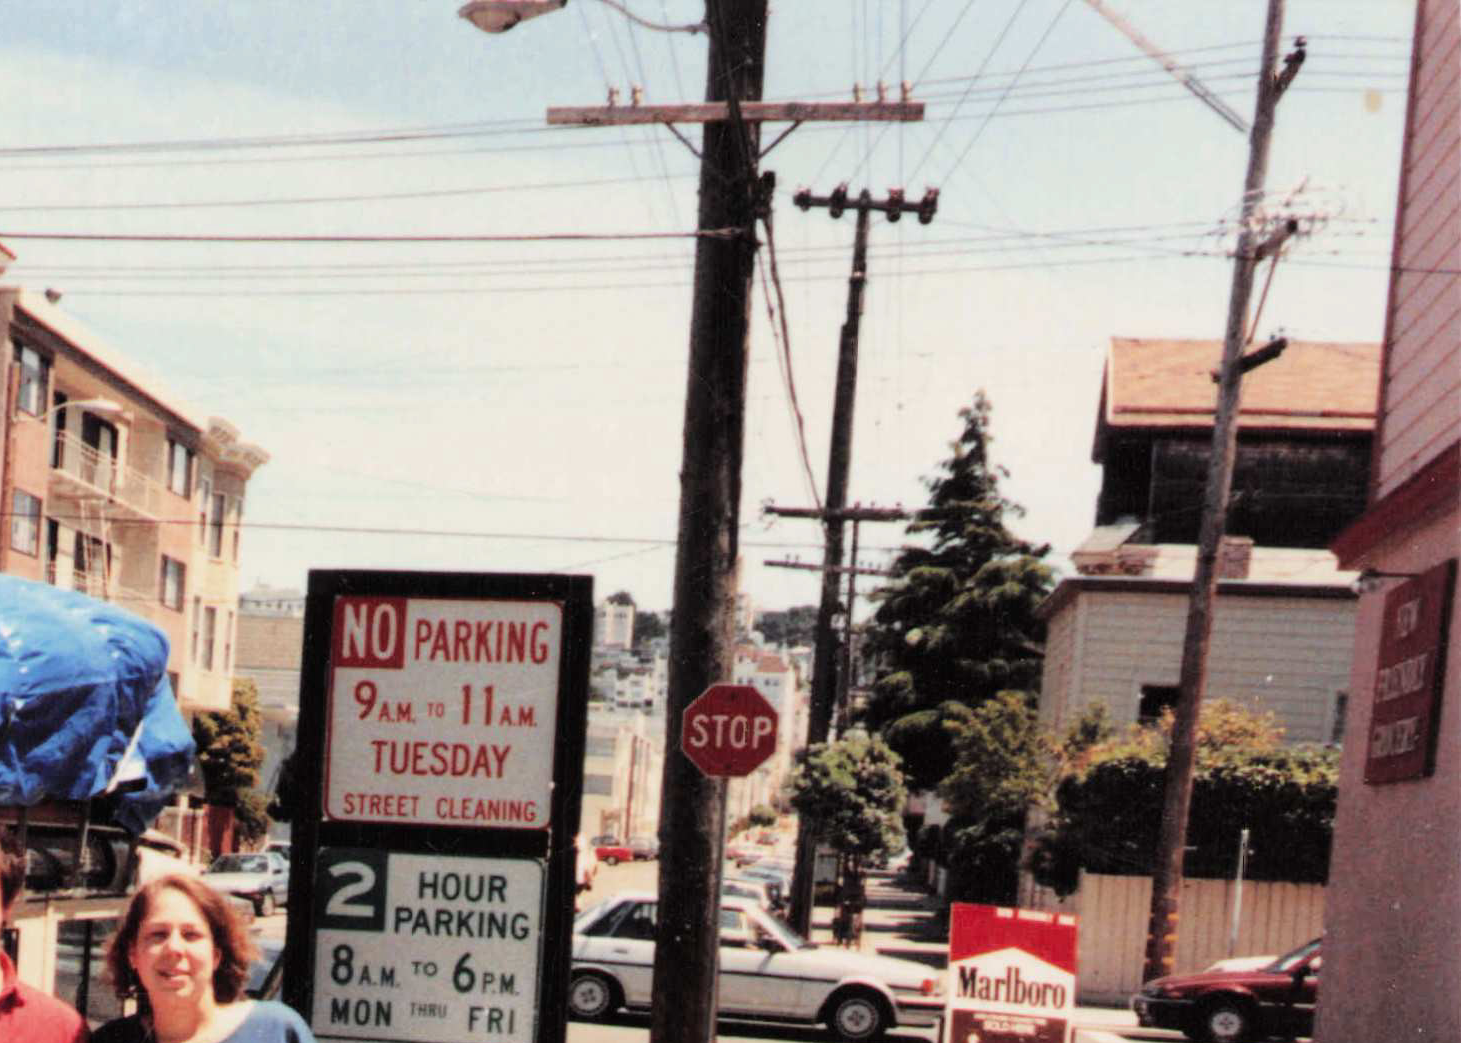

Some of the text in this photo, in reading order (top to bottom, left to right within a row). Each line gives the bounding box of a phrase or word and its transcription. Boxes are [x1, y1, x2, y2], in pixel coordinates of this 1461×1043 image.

[342, 602, 550, 664] NO PARKING
[427, 702, 444, 719] TO
[689, 714, 772, 749] STOP
[371, 740, 511, 779] TUESDAY
[344, 793, 537, 822] STREET CLEANING
[325, 861, 508, 918] 2 HOUR
[394, 907, 530, 941] PARKING
[411, 961, 438, 978] TO
[957, 965, 1066, 1010] Marlboro
[331, 998, 516, 1035] MON THRU FRI
